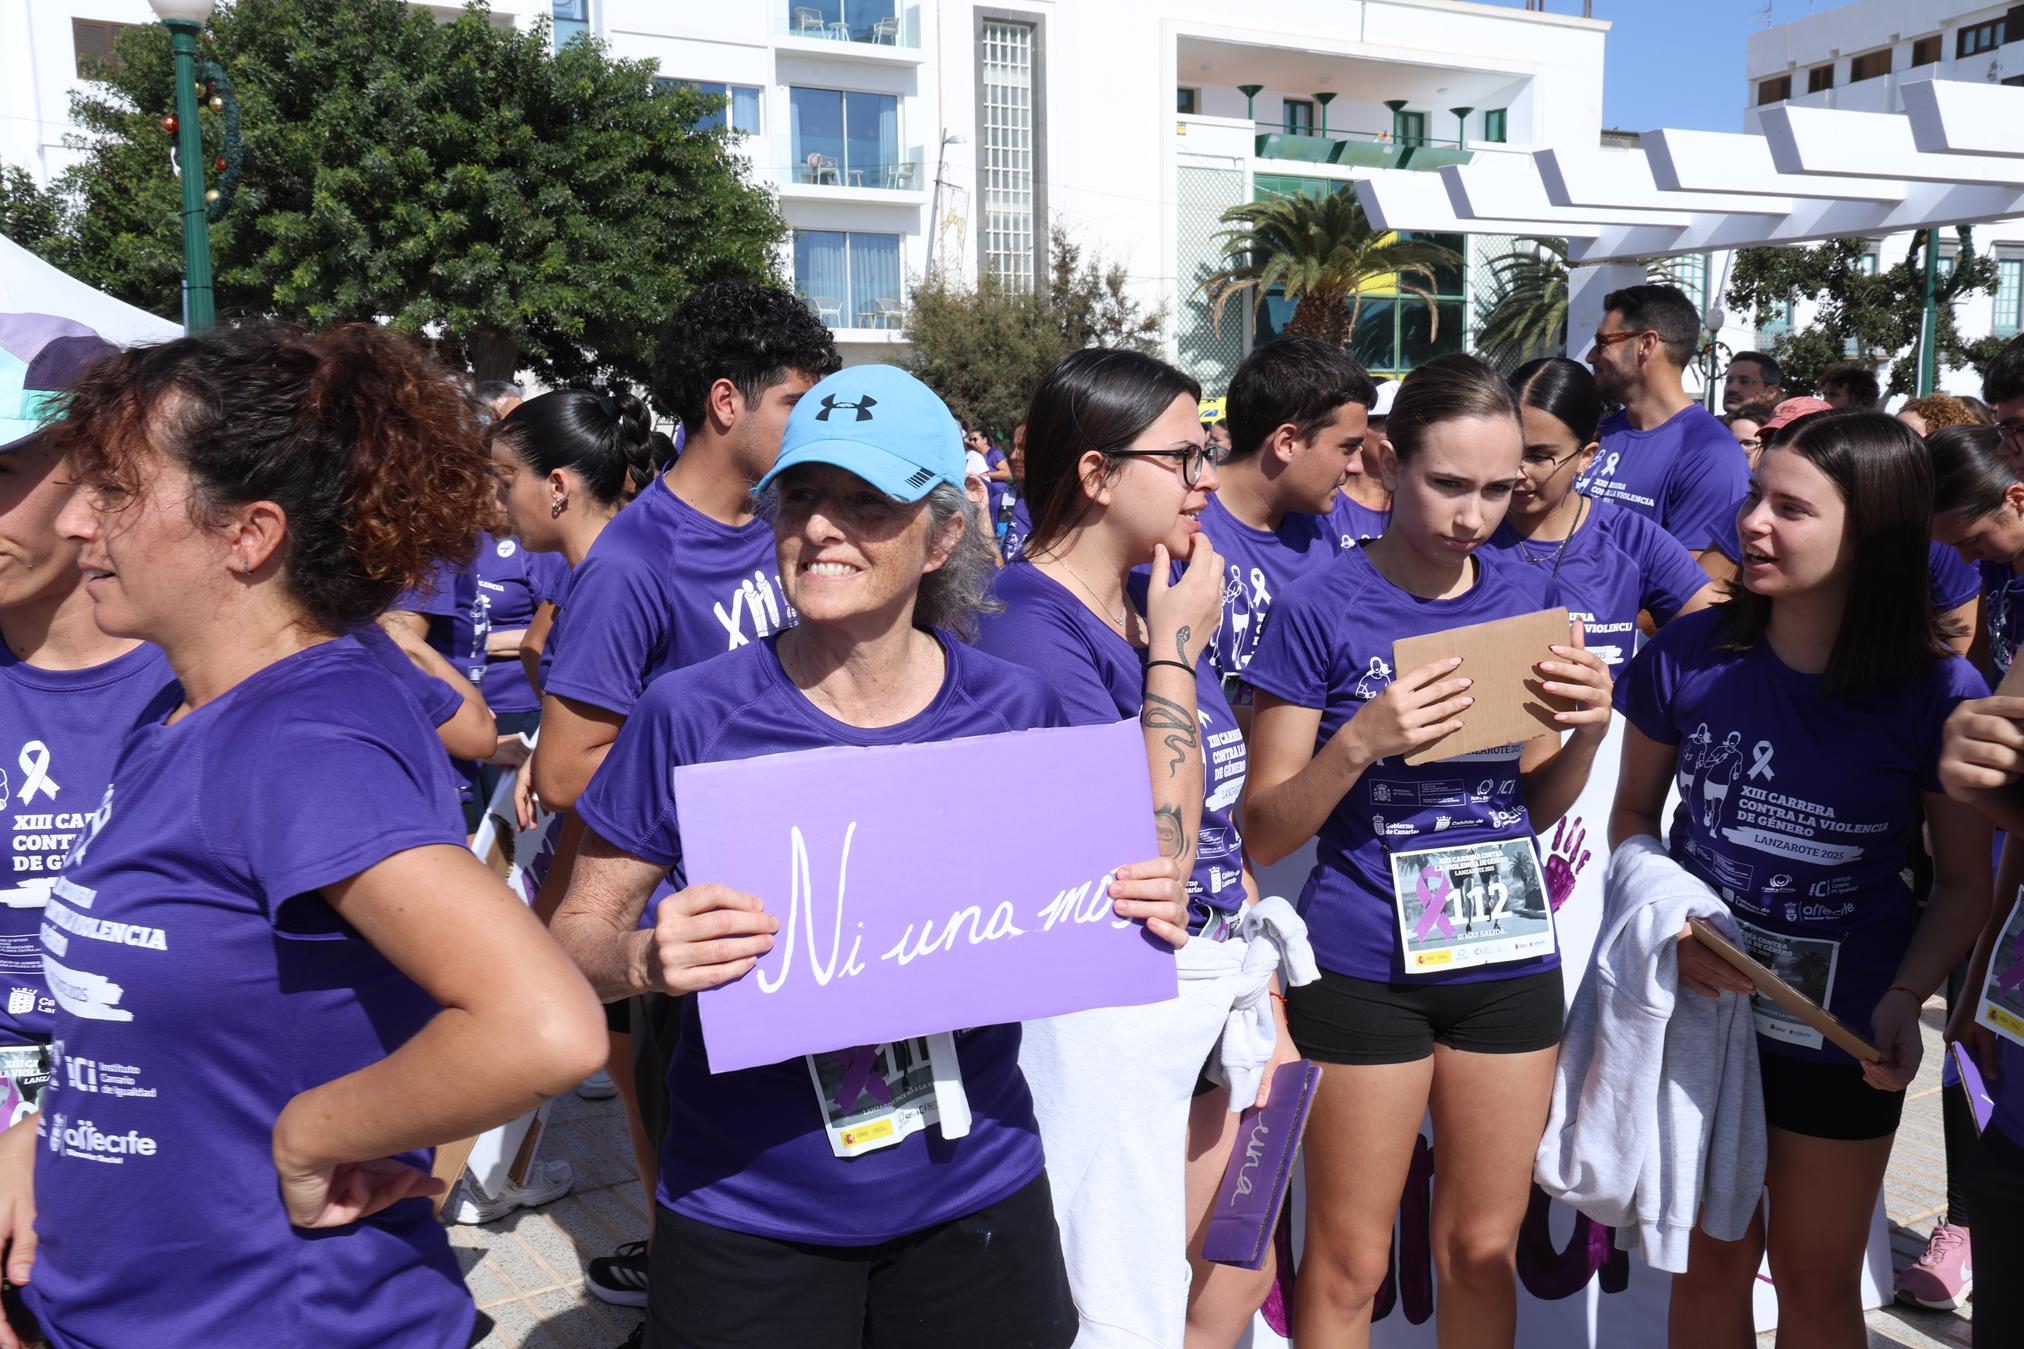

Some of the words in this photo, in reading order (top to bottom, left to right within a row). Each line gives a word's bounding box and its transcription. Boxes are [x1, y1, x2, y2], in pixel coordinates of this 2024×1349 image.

[1616, 490, 1655, 507] VIOLENCIA
[1214, 766, 1224, 781] DE
[1740, 785, 1769, 801] XIII
[1768, 792, 1836, 818] CARRERA
[12, 814, 53, 830] XIII
[1736, 810, 1756, 824] DE
[1757, 815, 1815, 837] GÉNERO
[1738, 798, 1796, 822] CONTRA
[1797, 813, 1817, 827] LA
[1819, 819, 1889, 834] VIOLENCIA
[12, 834, 77, 851] CONT
[1754, 833, 1820, 857] LANZAROTE
[1820, 848, 1846, 861] 2025
[12, 856, 43, 871] DE
[756, 821, 866, 994] Ni
[881, 900, 1025, 966] una
[1445, 883, 1513, 926] 112
